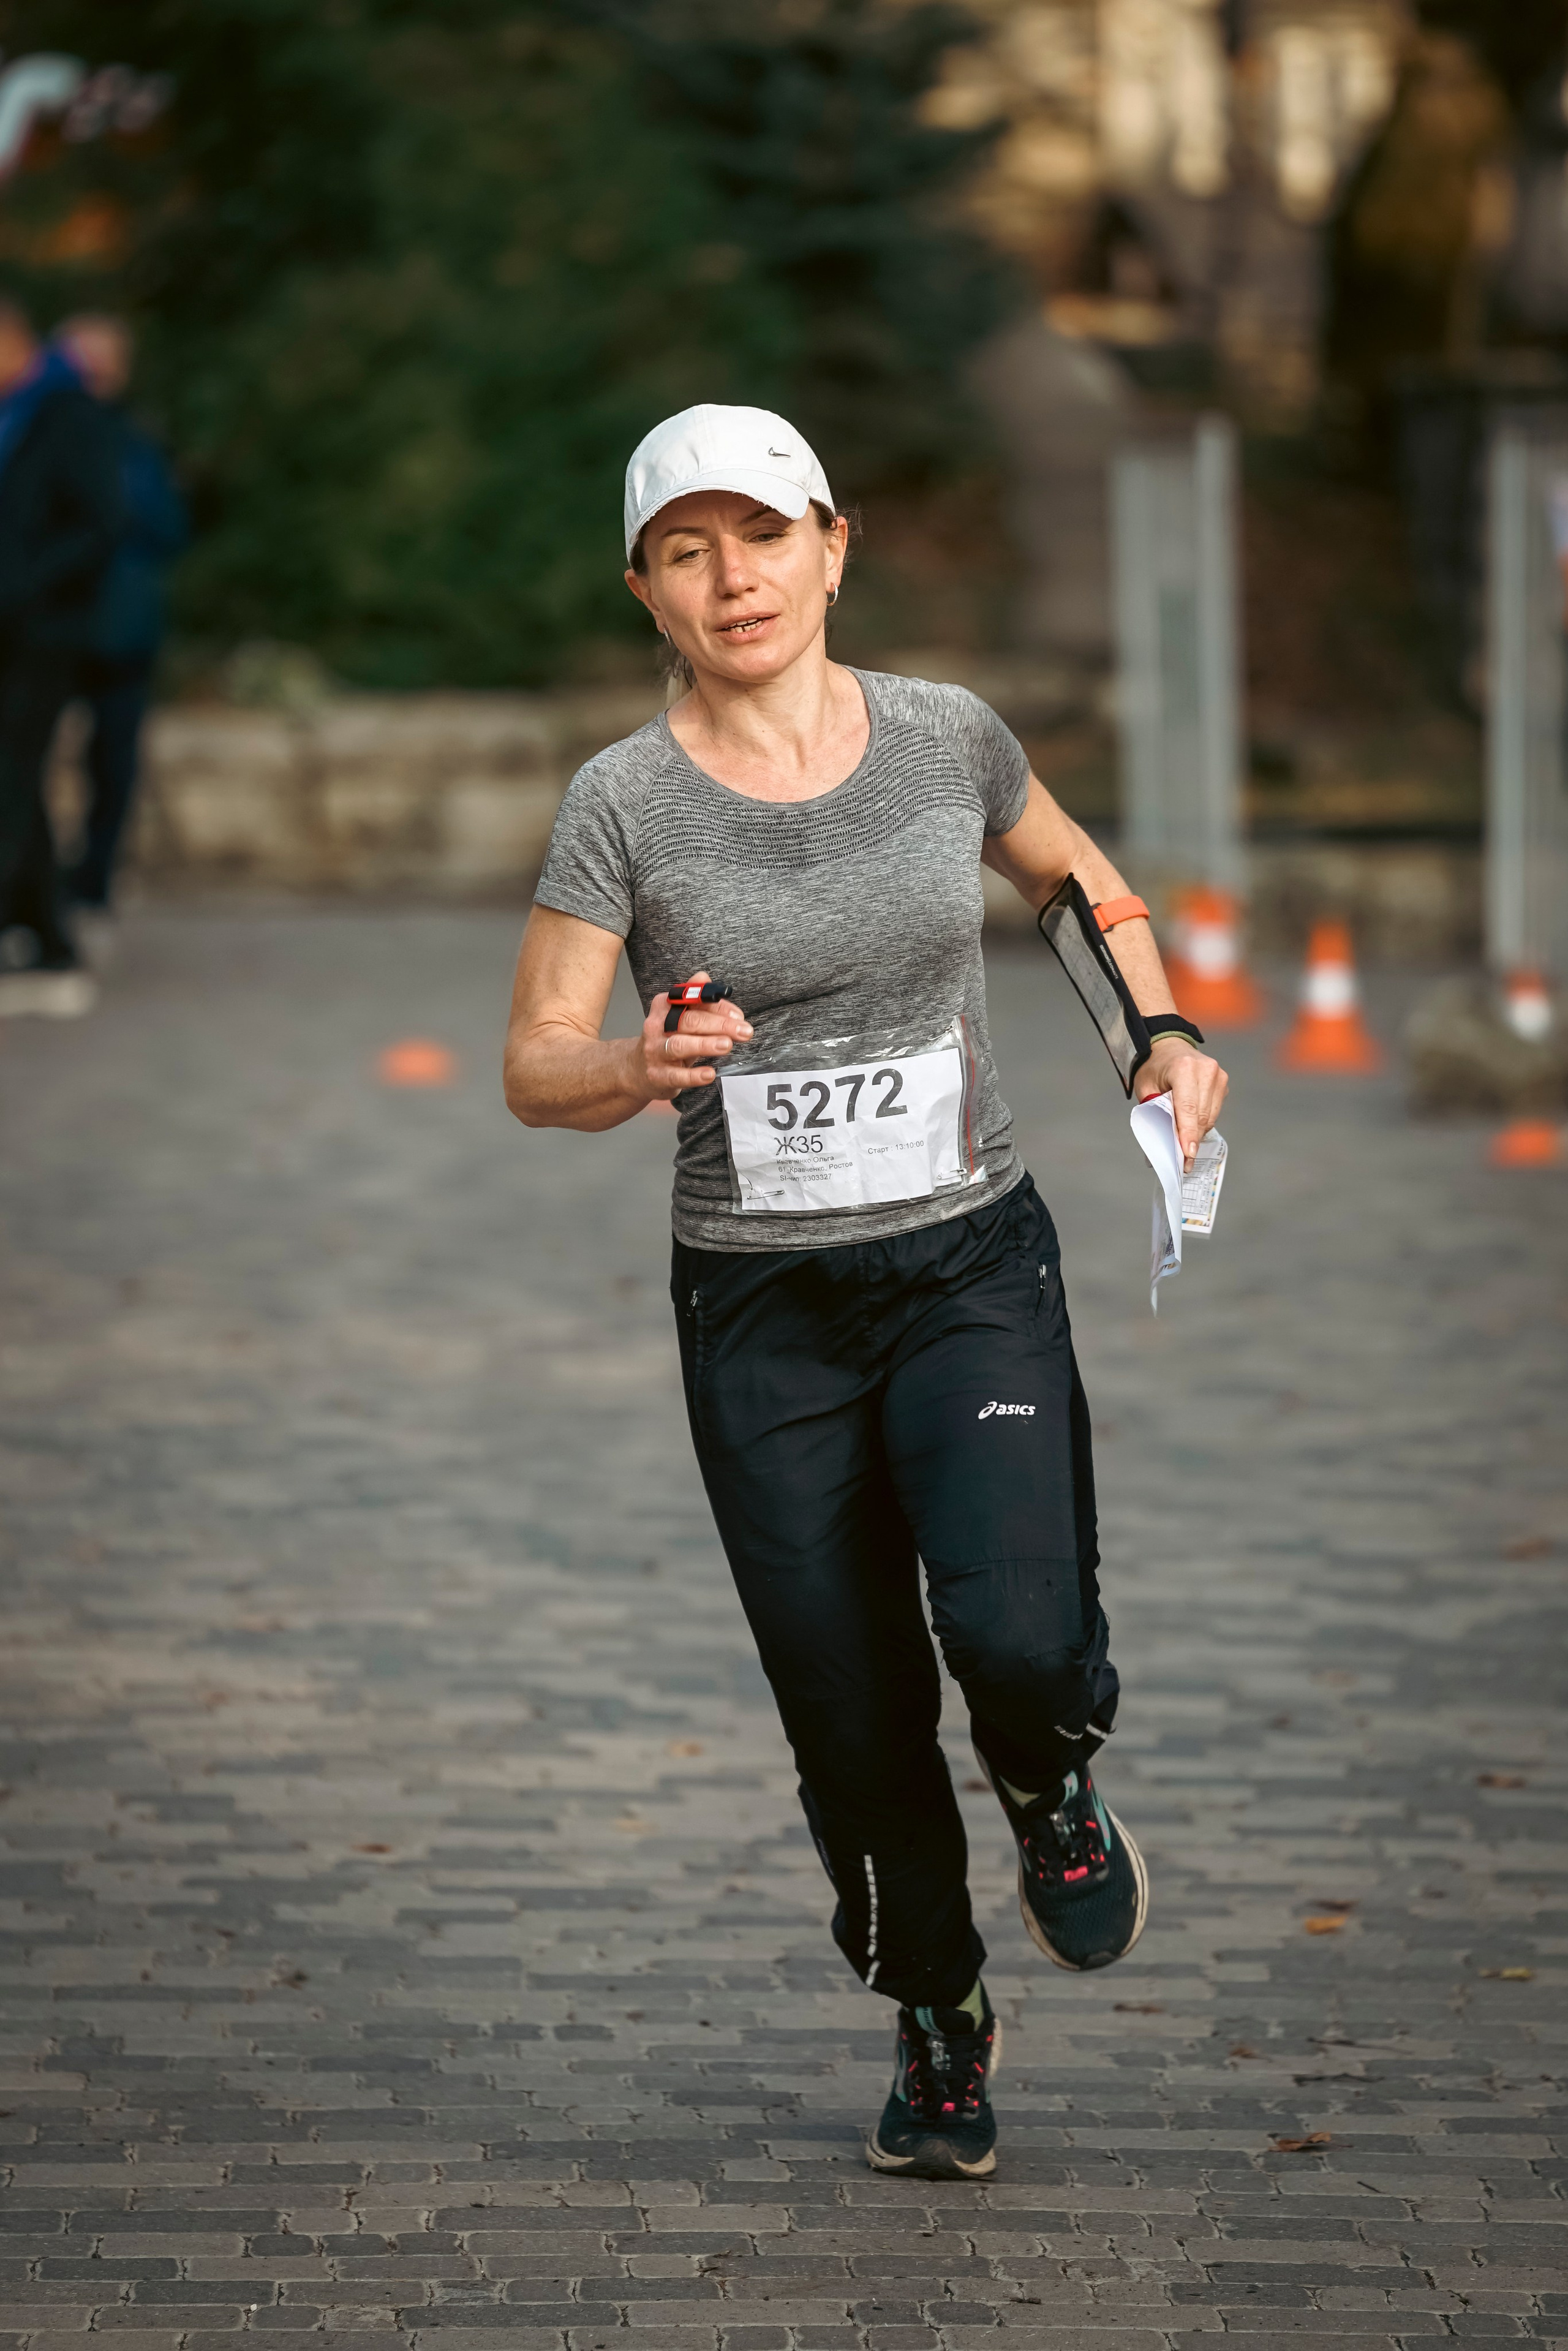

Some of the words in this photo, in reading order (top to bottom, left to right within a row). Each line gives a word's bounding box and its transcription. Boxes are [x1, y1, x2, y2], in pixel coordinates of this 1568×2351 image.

[767, 1068, 908, 1131] 5272
[774, 1134, 823, 1156] Ж35
[895, 1140, 924, 1150] 13:10:00
[803, 1173, 832, 1182] 2303327
